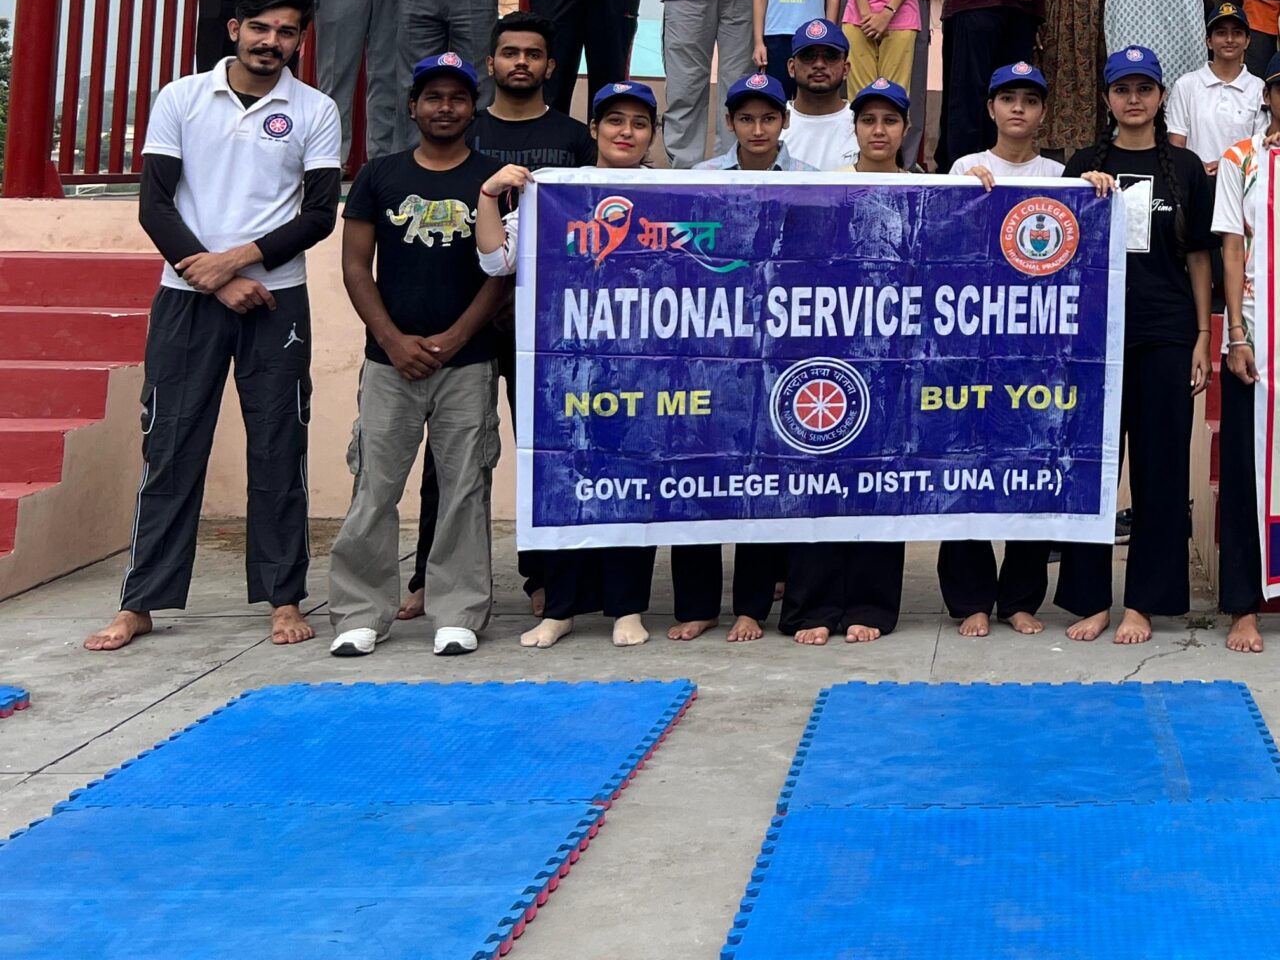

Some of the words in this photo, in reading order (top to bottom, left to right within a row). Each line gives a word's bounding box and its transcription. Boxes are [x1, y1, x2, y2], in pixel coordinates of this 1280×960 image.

[1005, 213, 1021, 241] GOVT
[1020, 203, 1066, 220] COLLEGE
[1063, 219, 1075, 241] UNA
[563, 287, 753, 340] NATIONAL
[765, 285, 923, 338] SERVICE
[933, 284, 1081, 336] SCHEME
[564, 392, 644, 417] NOT
[656, 390, 712, 416] ME
[920, 385, 993, 411] BUT
[1004, 385, 1078, 410] YOU
[783, 410, 807, 439] NATIONAL
[809, 431, 838, 442] SERVICE
[836, 409, 858, 436] SCHEME
[575, 478, 651, 501] GOVT.
[659, 474, 780, 499] COLLEGE
[788, 473, 849, 499] UNA,
[857, 470, 934, 494] DISTT.
[943, 468, 995, 491] UNA
[1002, 468, 1063, 497] (H.P.)
